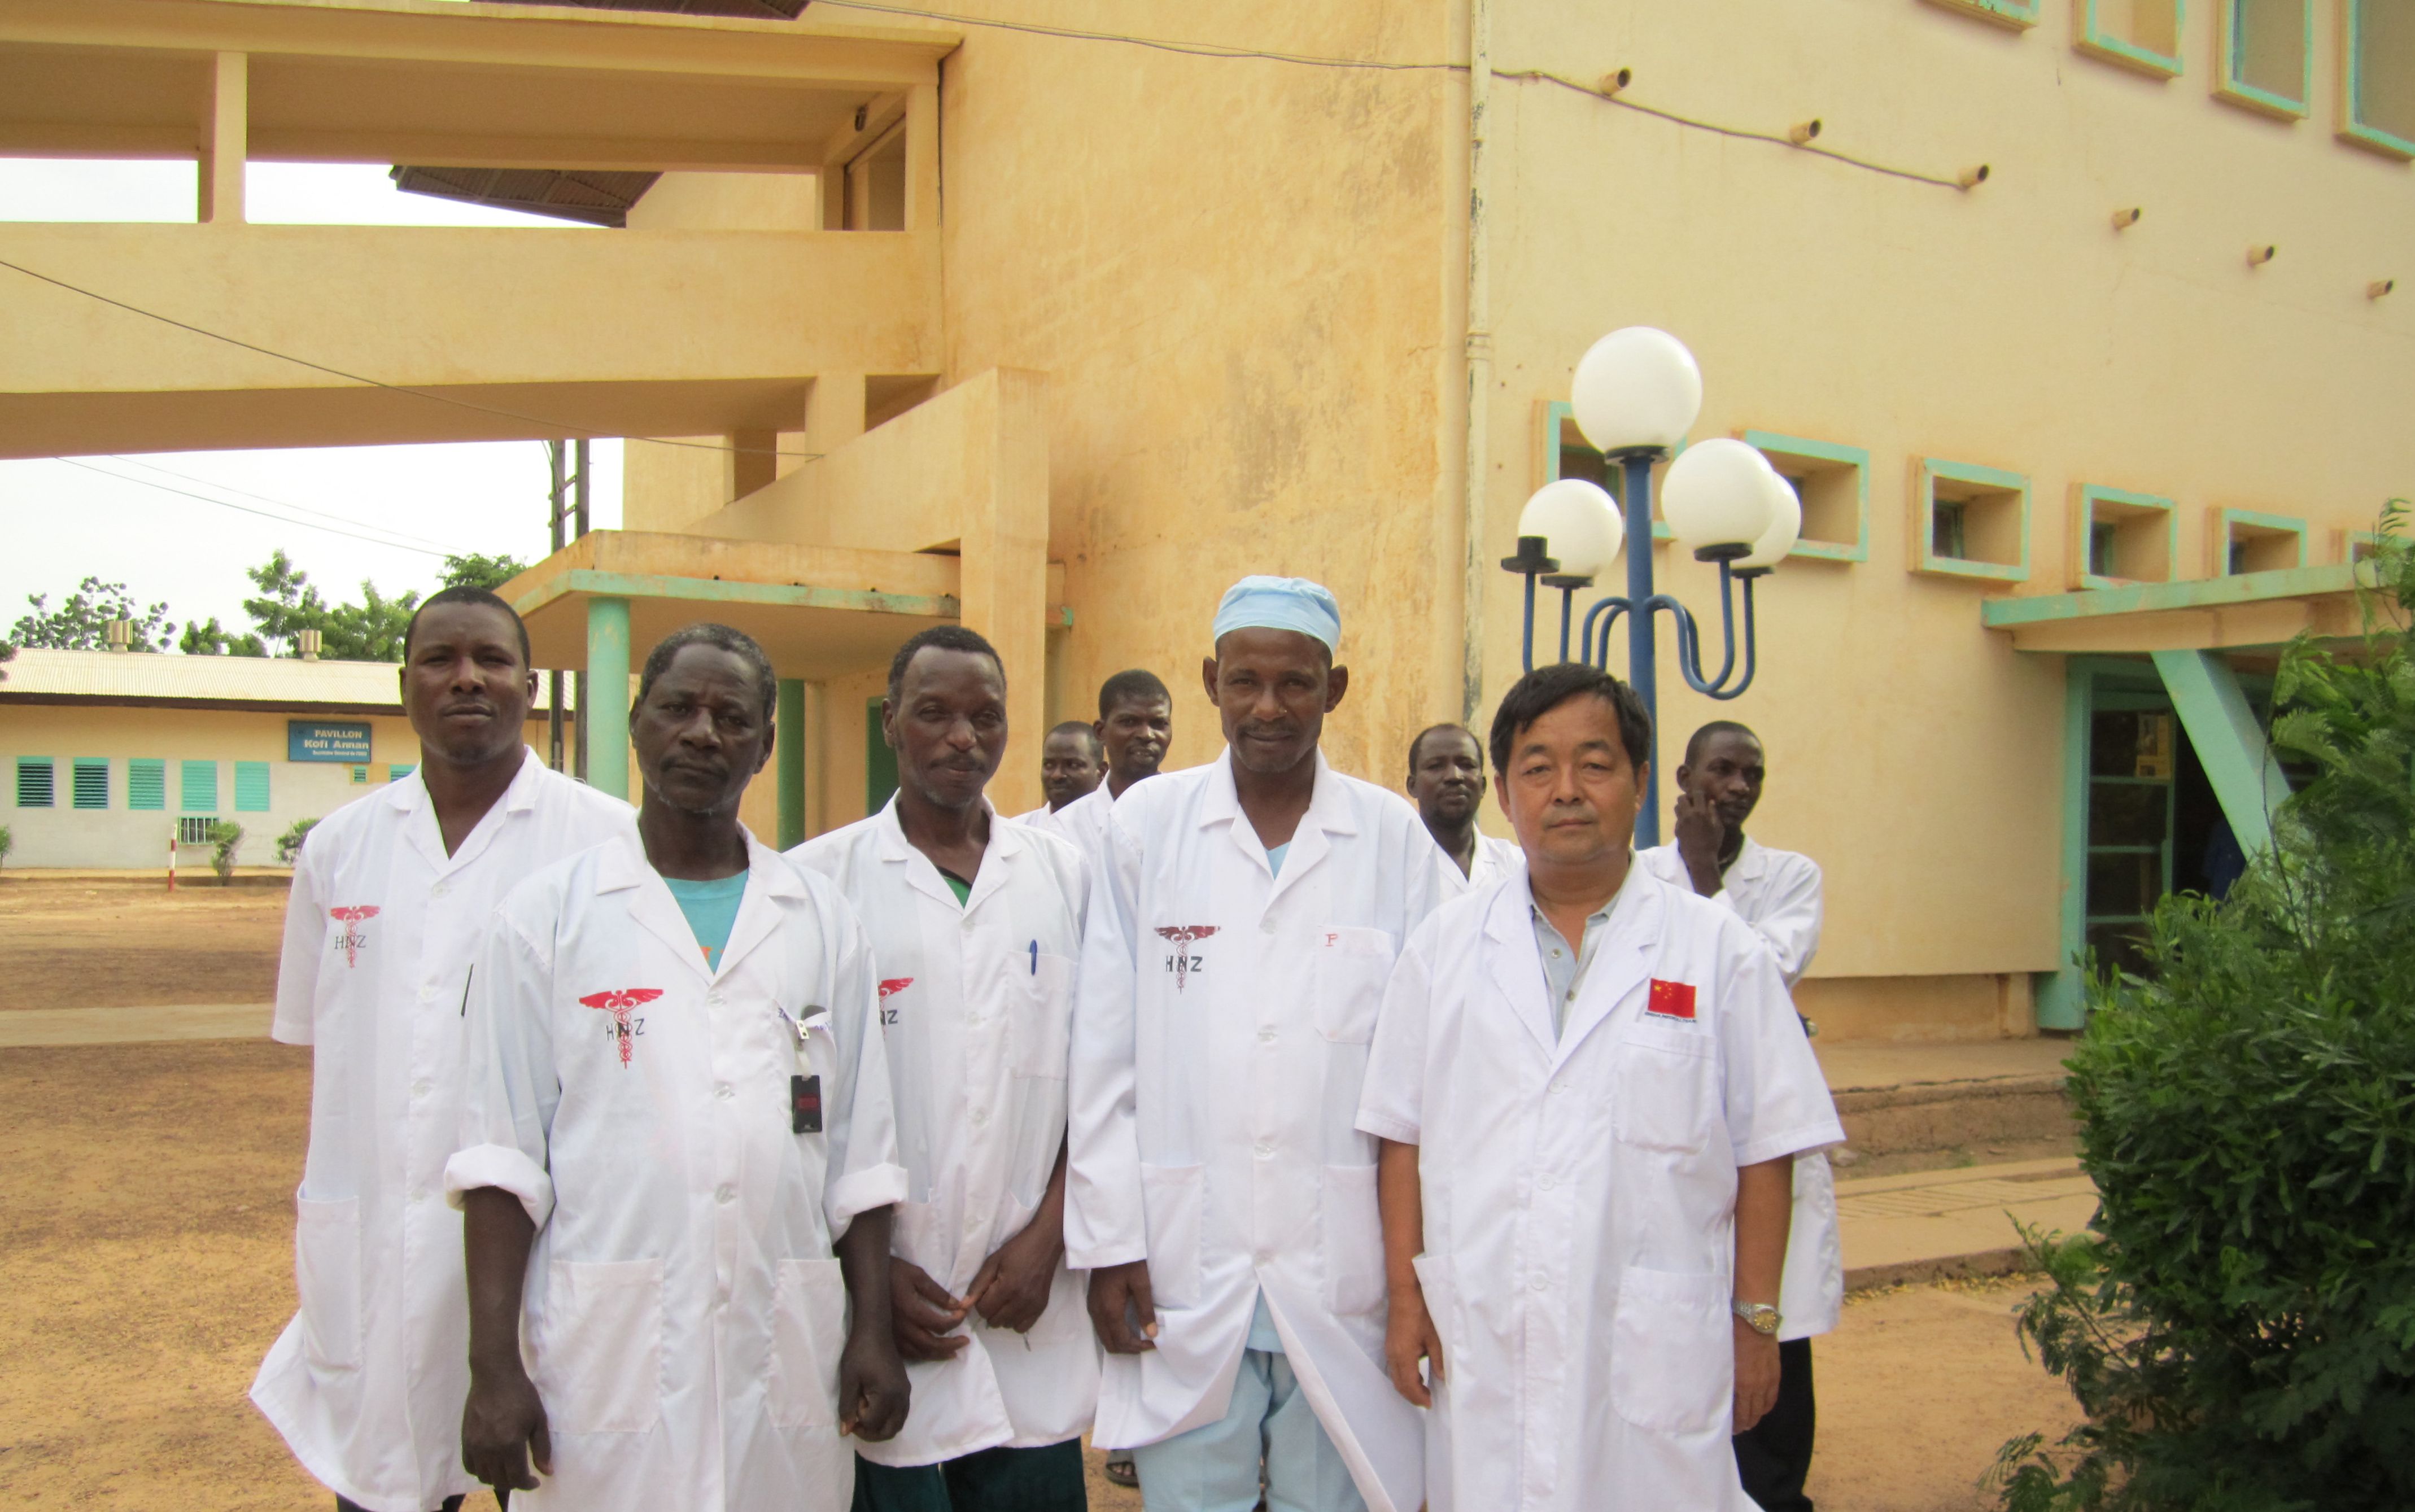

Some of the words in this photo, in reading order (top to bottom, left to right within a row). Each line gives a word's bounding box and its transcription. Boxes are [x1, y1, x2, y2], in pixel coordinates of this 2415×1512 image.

[315, 729, 362, 738] PAVILLON
[304, 740, 328, 749] Kofi
[333, 740, 369, 749] Annan
[1325, 933, 1338, 947] P
